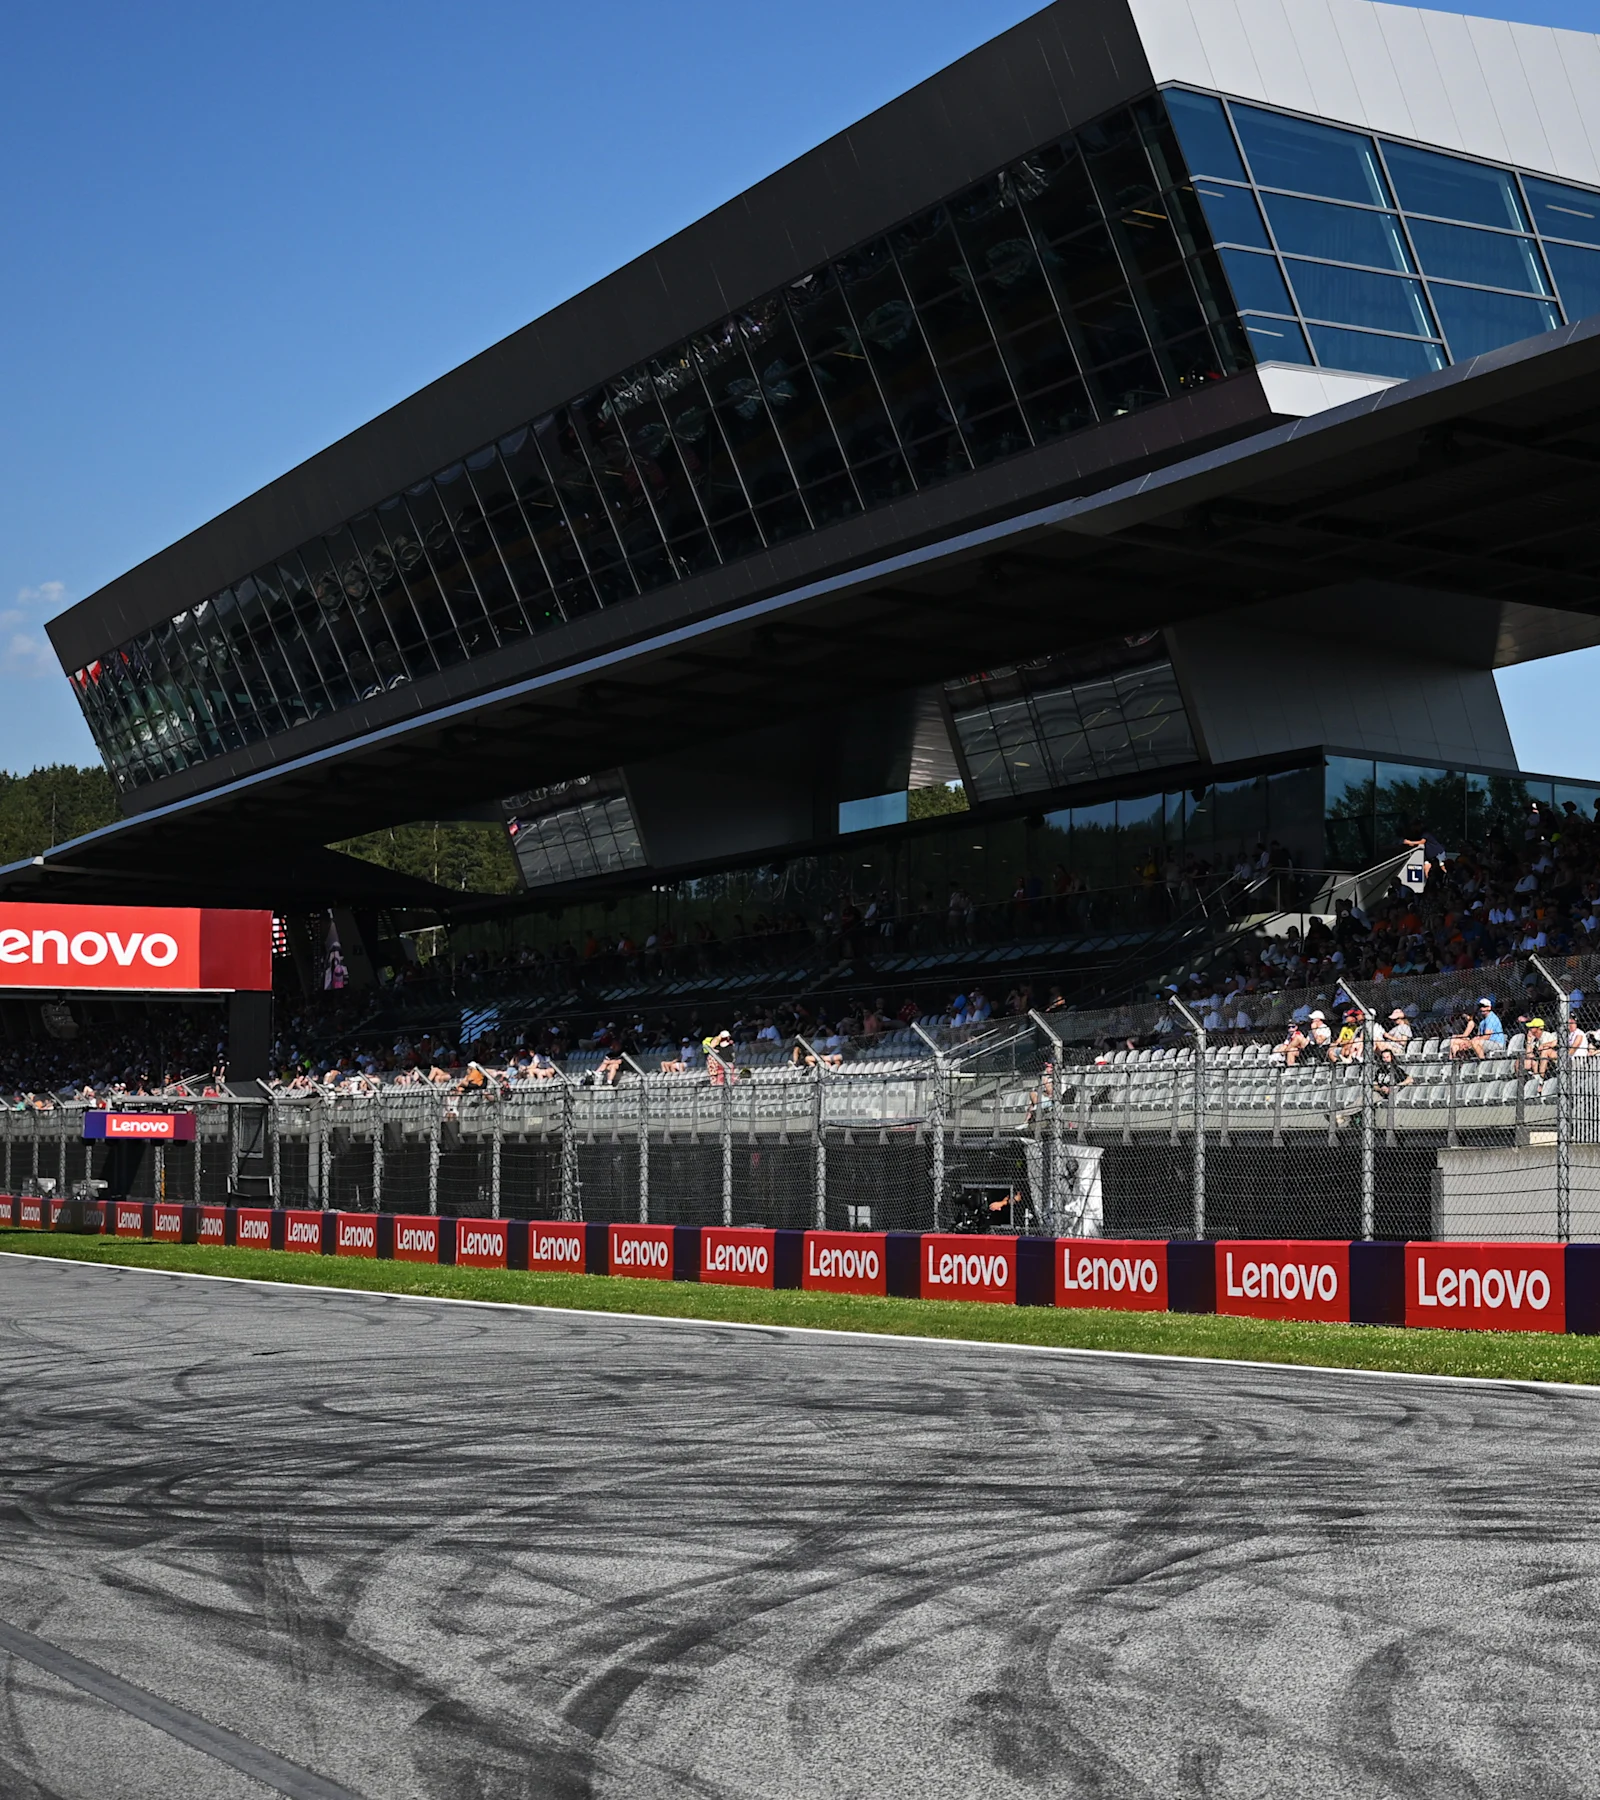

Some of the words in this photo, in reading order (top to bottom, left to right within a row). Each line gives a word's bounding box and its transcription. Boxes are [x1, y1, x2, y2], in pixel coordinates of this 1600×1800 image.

[1411, 870, 1419, 881] L
[0, 929, 178, 967] enovo
[112, 1119, 169, 1133] Lenovo
[21, 1202, 41, 1222] Lenovo
[118, 1208, 142, 1230] Lenovo
[155, 1210, 181, 1232] Lenovo
[197, 1212, 223, 1237] Lenovo
[239, 1215, 269, 1240] Lenovo
[287, 1217, 319, 1244] Lenovo
[339, 1220, 374, 1248] Lenovo
[397, 1223, 436, 1252] Lenovo
[461, 1226, 503, 1257] Lenovo
[532, 1229, 581, 1262] Lenovo
[613, 1233, 668, 1267] Lenovo
[706, 1237, 768, 1274] Lenovo
[809, 1241, 879, 1280] Lenovo
[928, 1245, 1008, 1287] Lenovo
[1064, 1248, 1158, 1293] Lenovo
[1226, 1252, 1337, 1302] Lenovo
[1418, 1258, 1550, 1310] Lenovo
